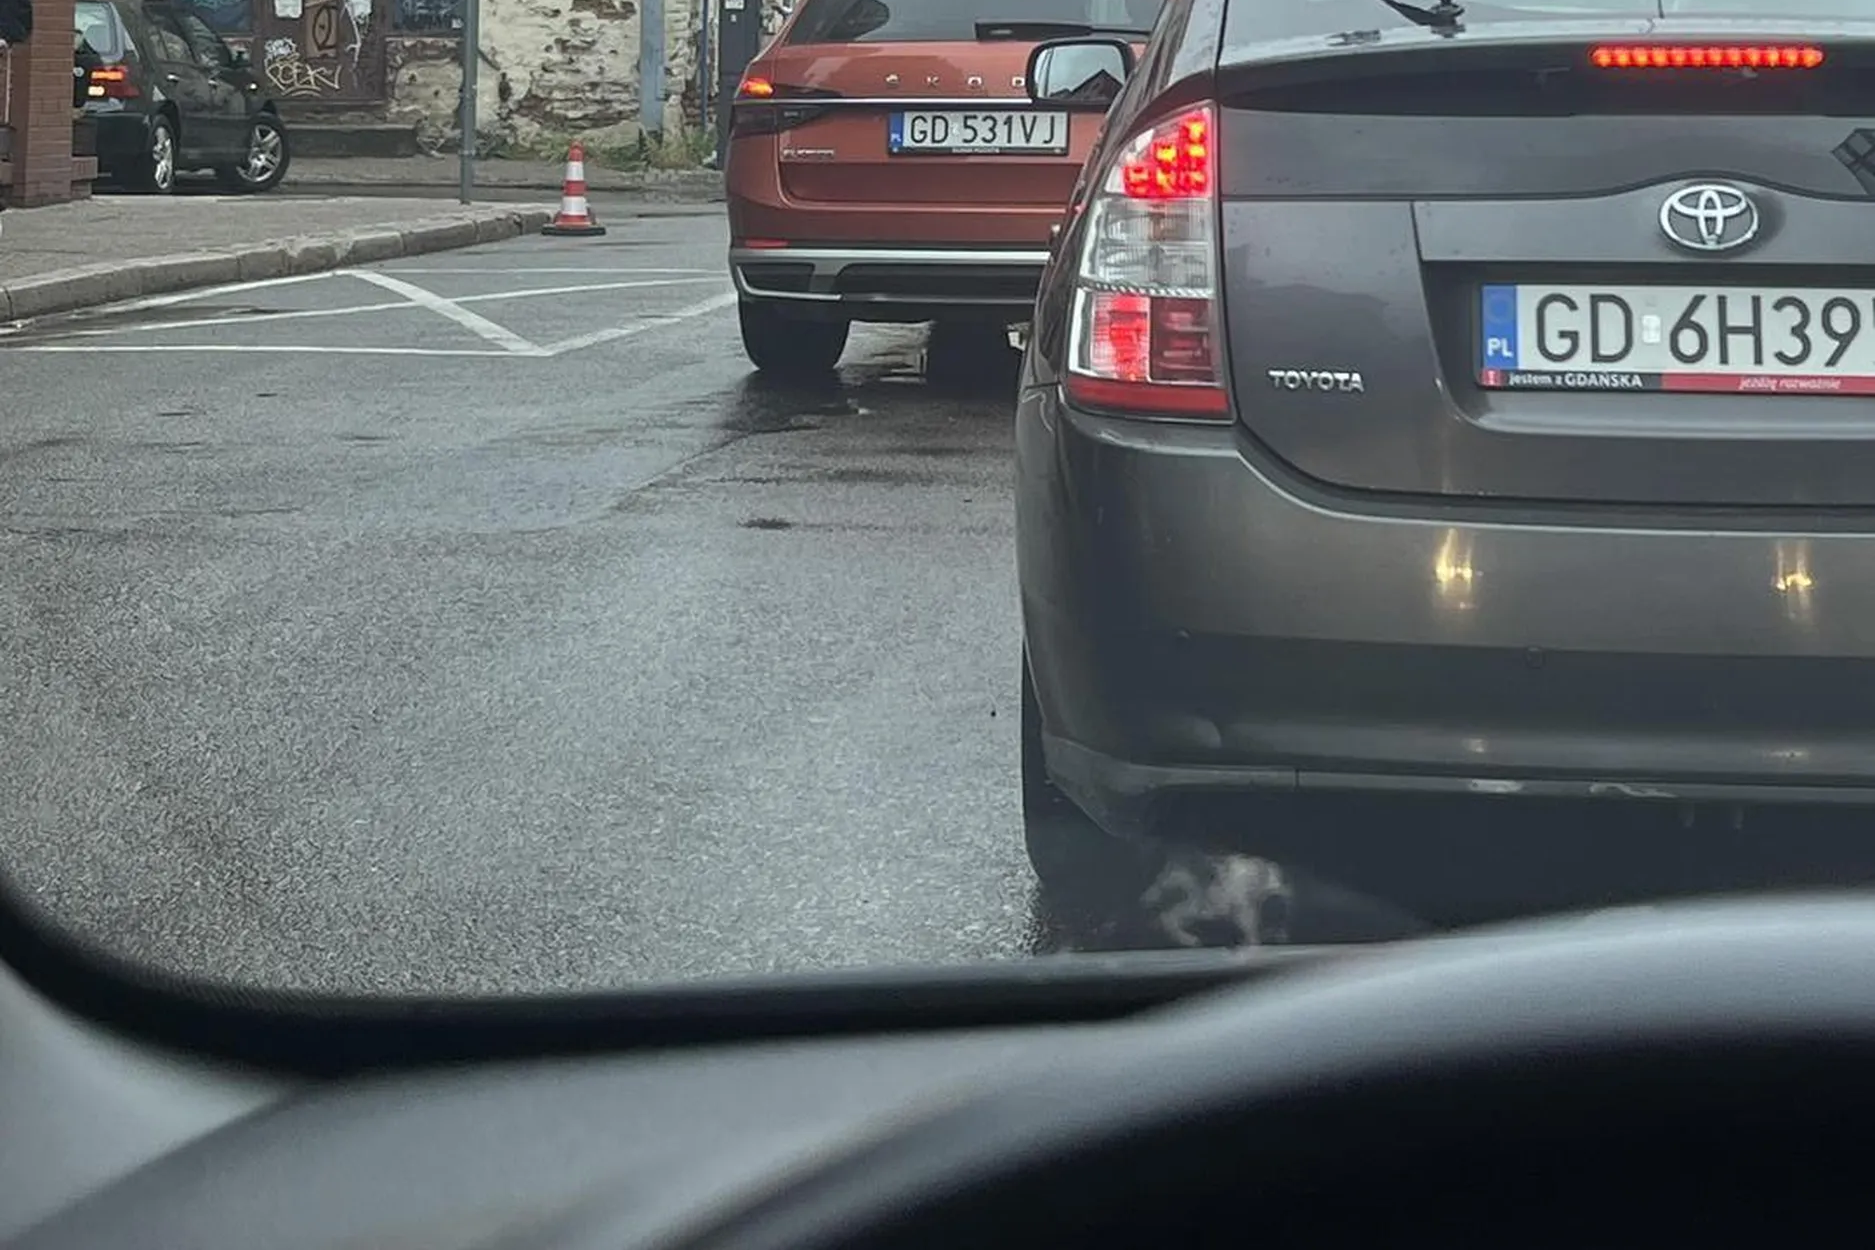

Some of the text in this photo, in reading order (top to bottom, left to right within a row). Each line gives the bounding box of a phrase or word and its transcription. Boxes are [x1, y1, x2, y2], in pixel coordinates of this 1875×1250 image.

[909, 113, 1056, 145] GD 531VJ
[1535, 292, 1875, 368] GD 6H39
[1486, 337, 1514, 358] PL
[1267, 369, 1365, 393] TOYOTA
